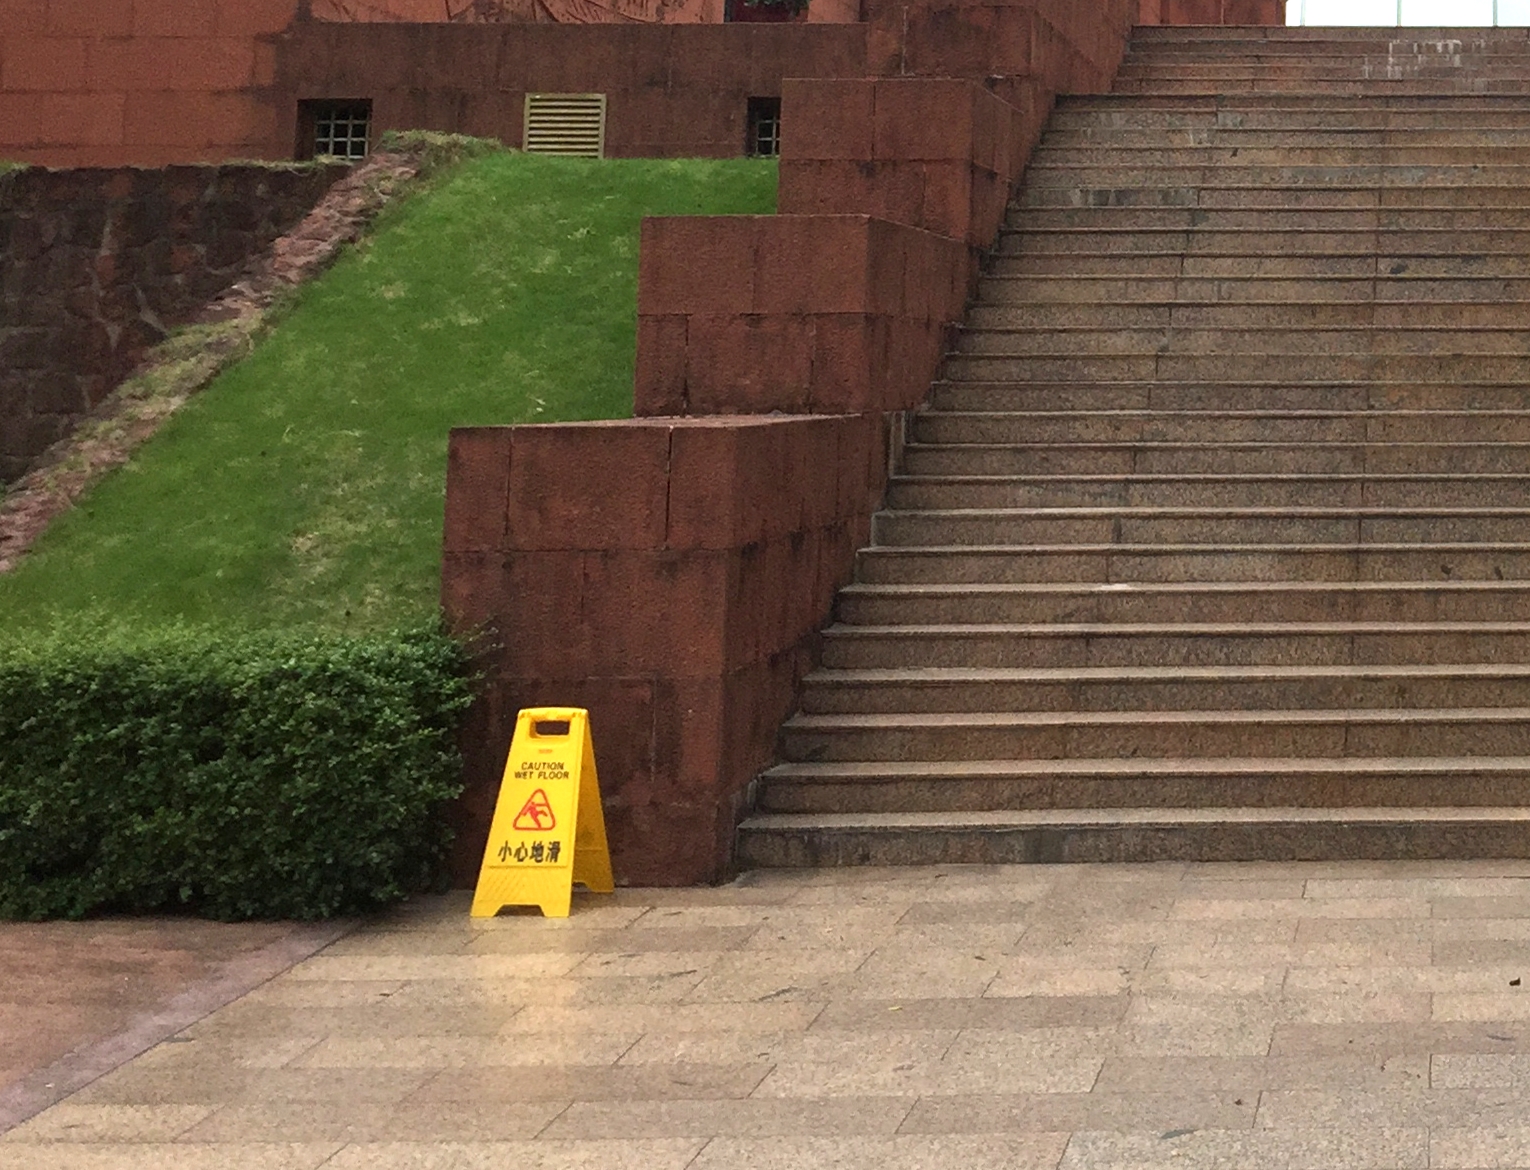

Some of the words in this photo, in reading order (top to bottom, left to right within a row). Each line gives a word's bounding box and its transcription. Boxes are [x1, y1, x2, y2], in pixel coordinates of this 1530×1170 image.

[521, 761, 565, 770] CAUTION
[514, 771, 534, 780] WET
[537, 771, 570, 780] FLOOR
[497, 840, 561, 864] 小心地滑
